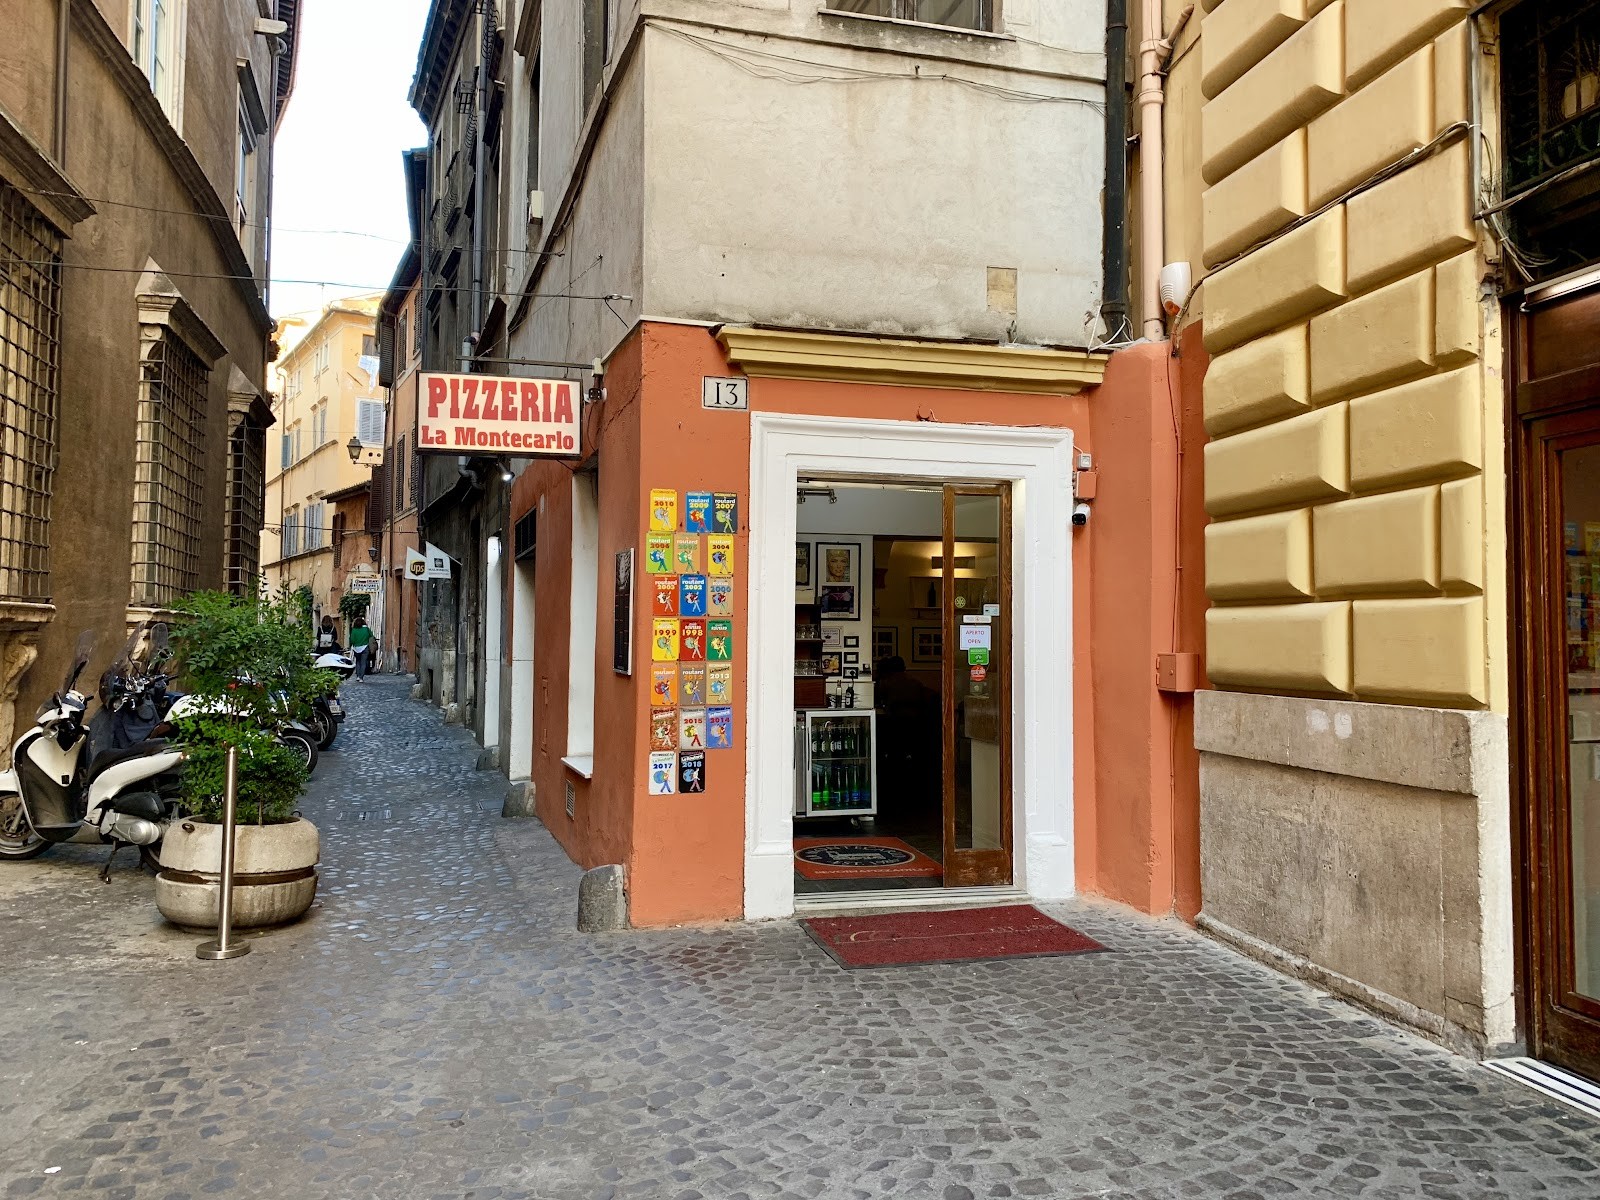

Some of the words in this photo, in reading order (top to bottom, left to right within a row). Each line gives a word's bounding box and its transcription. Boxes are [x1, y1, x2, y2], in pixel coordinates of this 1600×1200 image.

[427, 377, 574, 424] PIZZERIA
[714, 381, 738, 405] 13
[421, 425, 447, 445] La
[454, 426, 574, 450] Montecarlo
[410, 564, 424, 574] ups
